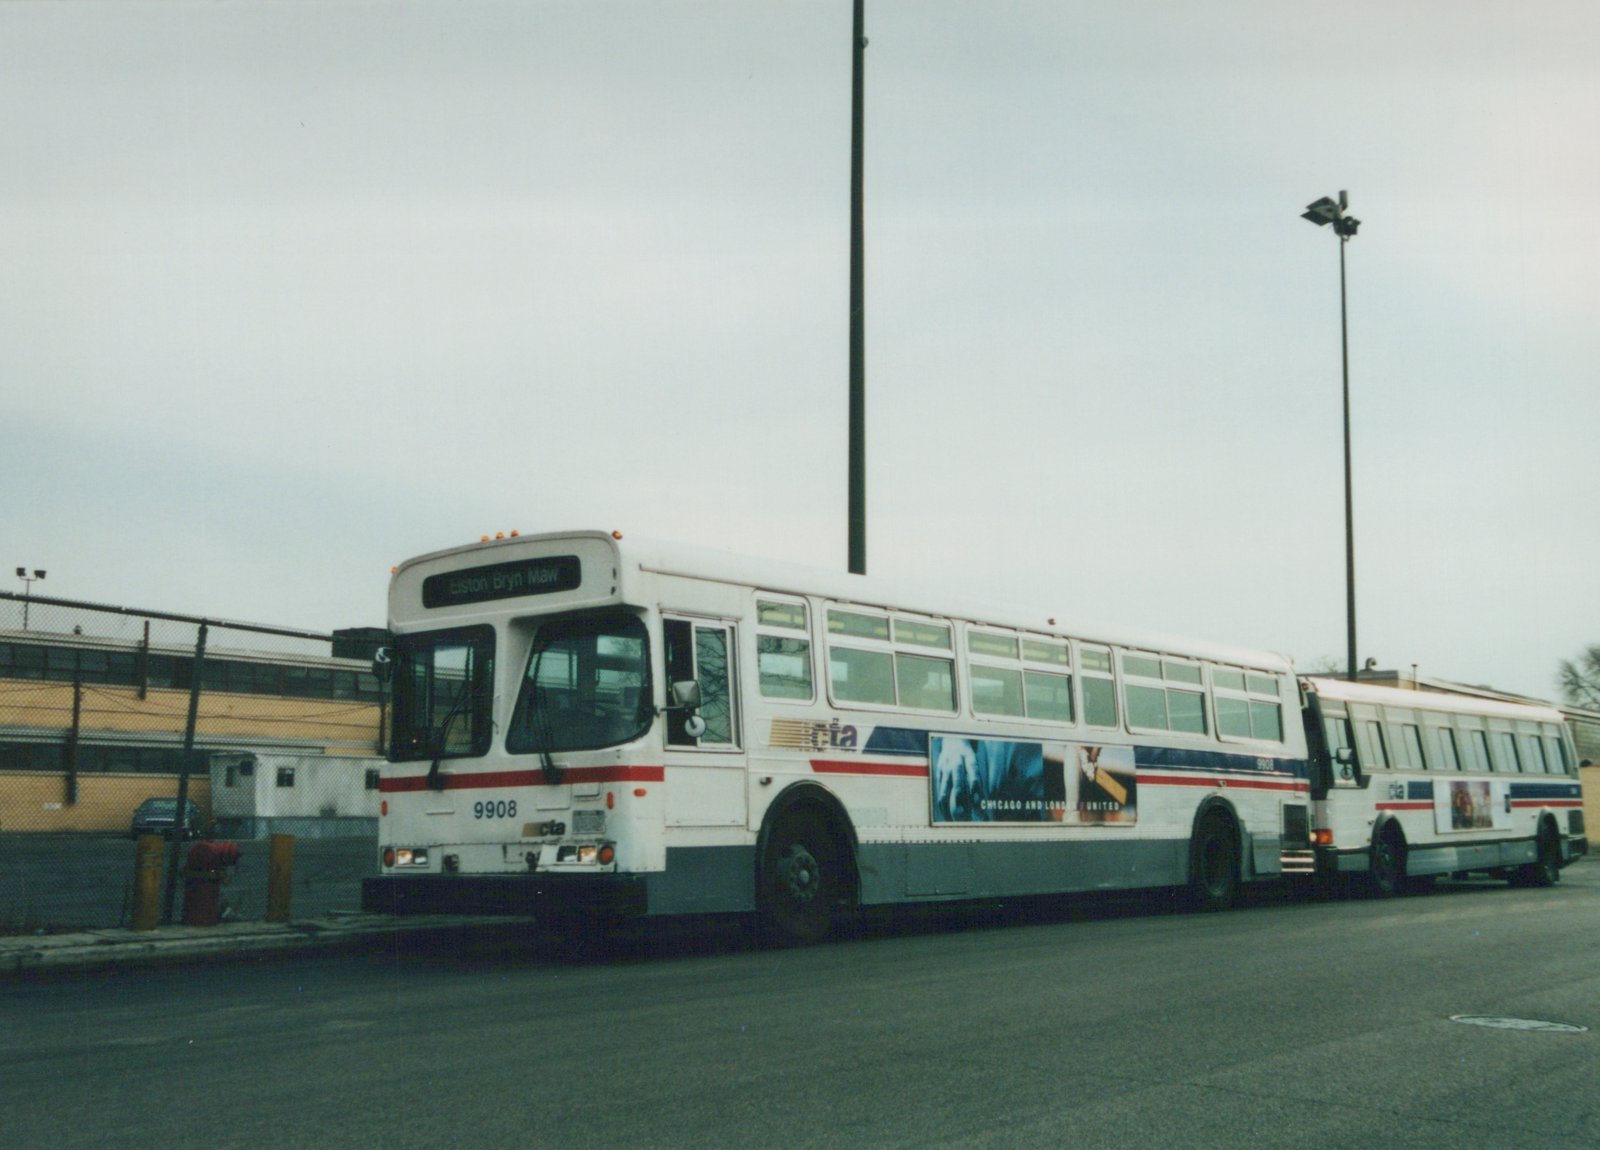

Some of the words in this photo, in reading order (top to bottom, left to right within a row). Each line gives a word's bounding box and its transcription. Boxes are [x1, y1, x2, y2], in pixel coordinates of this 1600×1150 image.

[493, 571, 523, 592] Bryn
[527, 567, 560, 585] Maw
[1256, 758, 1274, 771] 9908
[474, 800, 518, 819] 9908
[980, 799, 1022, 811] CHICAGO
[1025, 800, 1043, 811] AND
[1045, 800, 1078, 811] LOND
[1087, 801, 1120, 812] UNITED
[538, 820, 566, 837] cta
